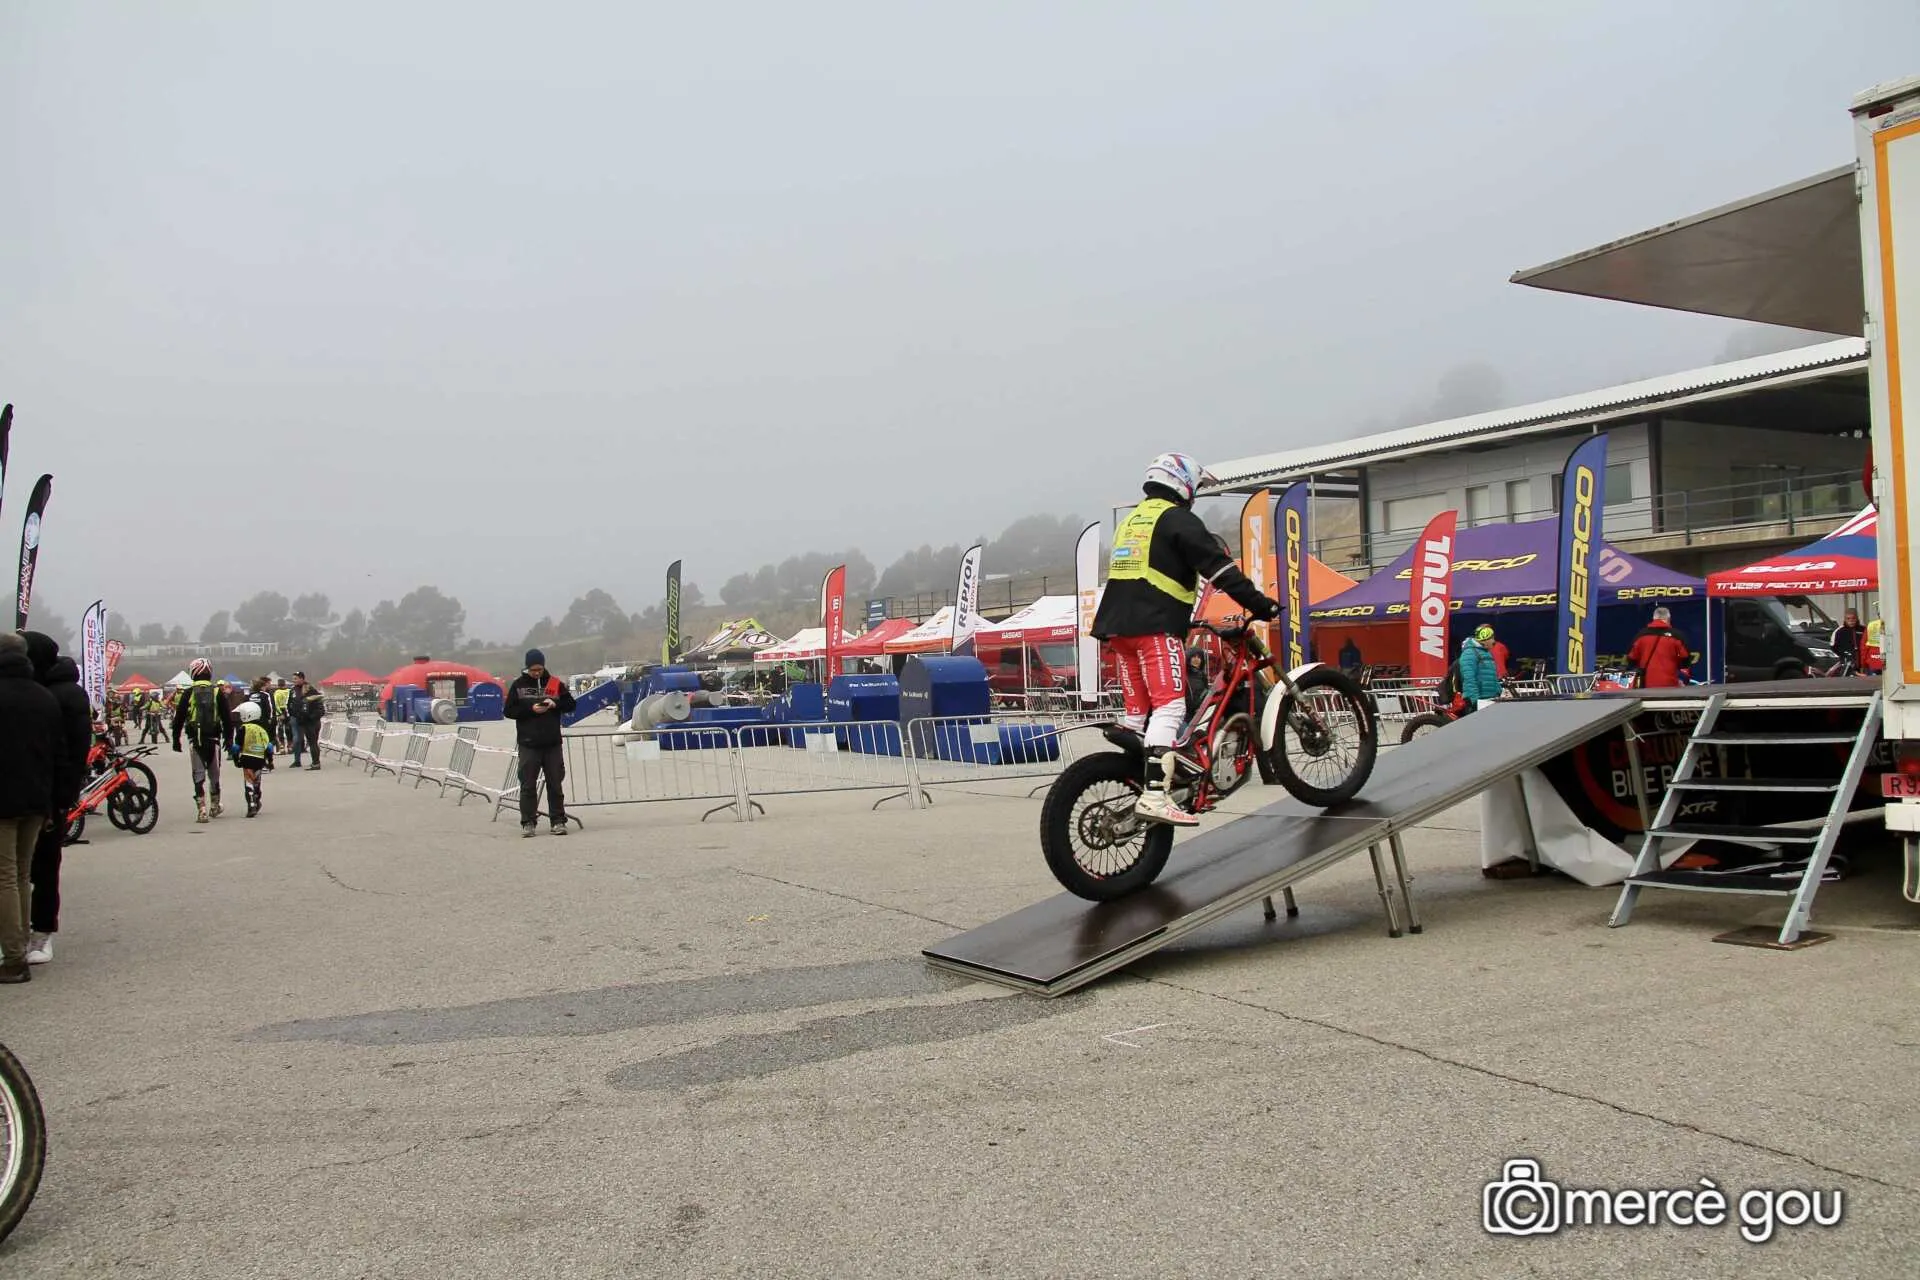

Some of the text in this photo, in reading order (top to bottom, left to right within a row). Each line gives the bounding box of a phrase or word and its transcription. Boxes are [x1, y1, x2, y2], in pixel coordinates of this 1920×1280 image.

[958, 557, 973, 628] REPSOL
[1286, 508, 1303, 673] SHERCO
[1420, 536, 1451, 659] MOTUL
[1568, 465, 1594, 674] SHERCO
[1617, 586, 1694, 600] SHERCO
[1679, 801, 1718, 816] XTR
